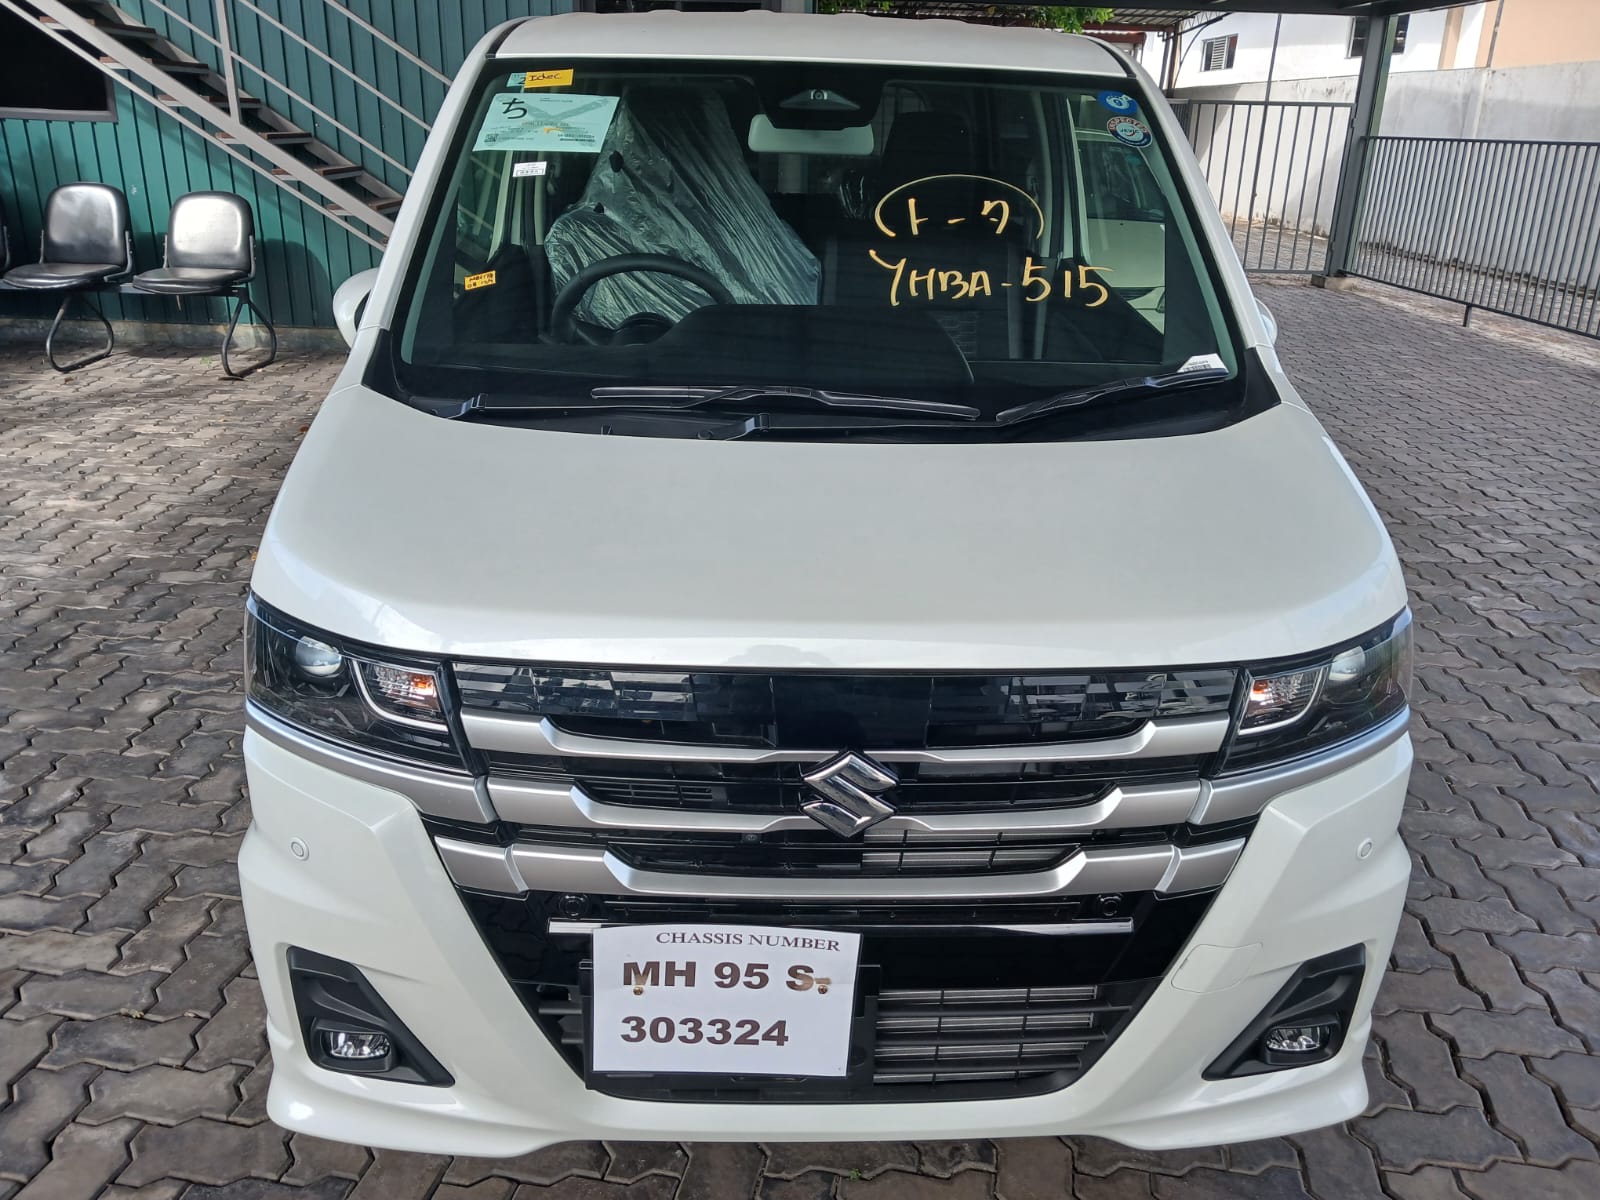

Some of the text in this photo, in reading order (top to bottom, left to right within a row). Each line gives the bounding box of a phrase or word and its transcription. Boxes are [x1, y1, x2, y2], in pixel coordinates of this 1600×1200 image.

[656, 931, 841, 952] CHASSIS NUMBER
[623, 960, 697, 987] MH
[713, 961, 770, 990] 95
[620, 1015, 790, 1047] 303324
